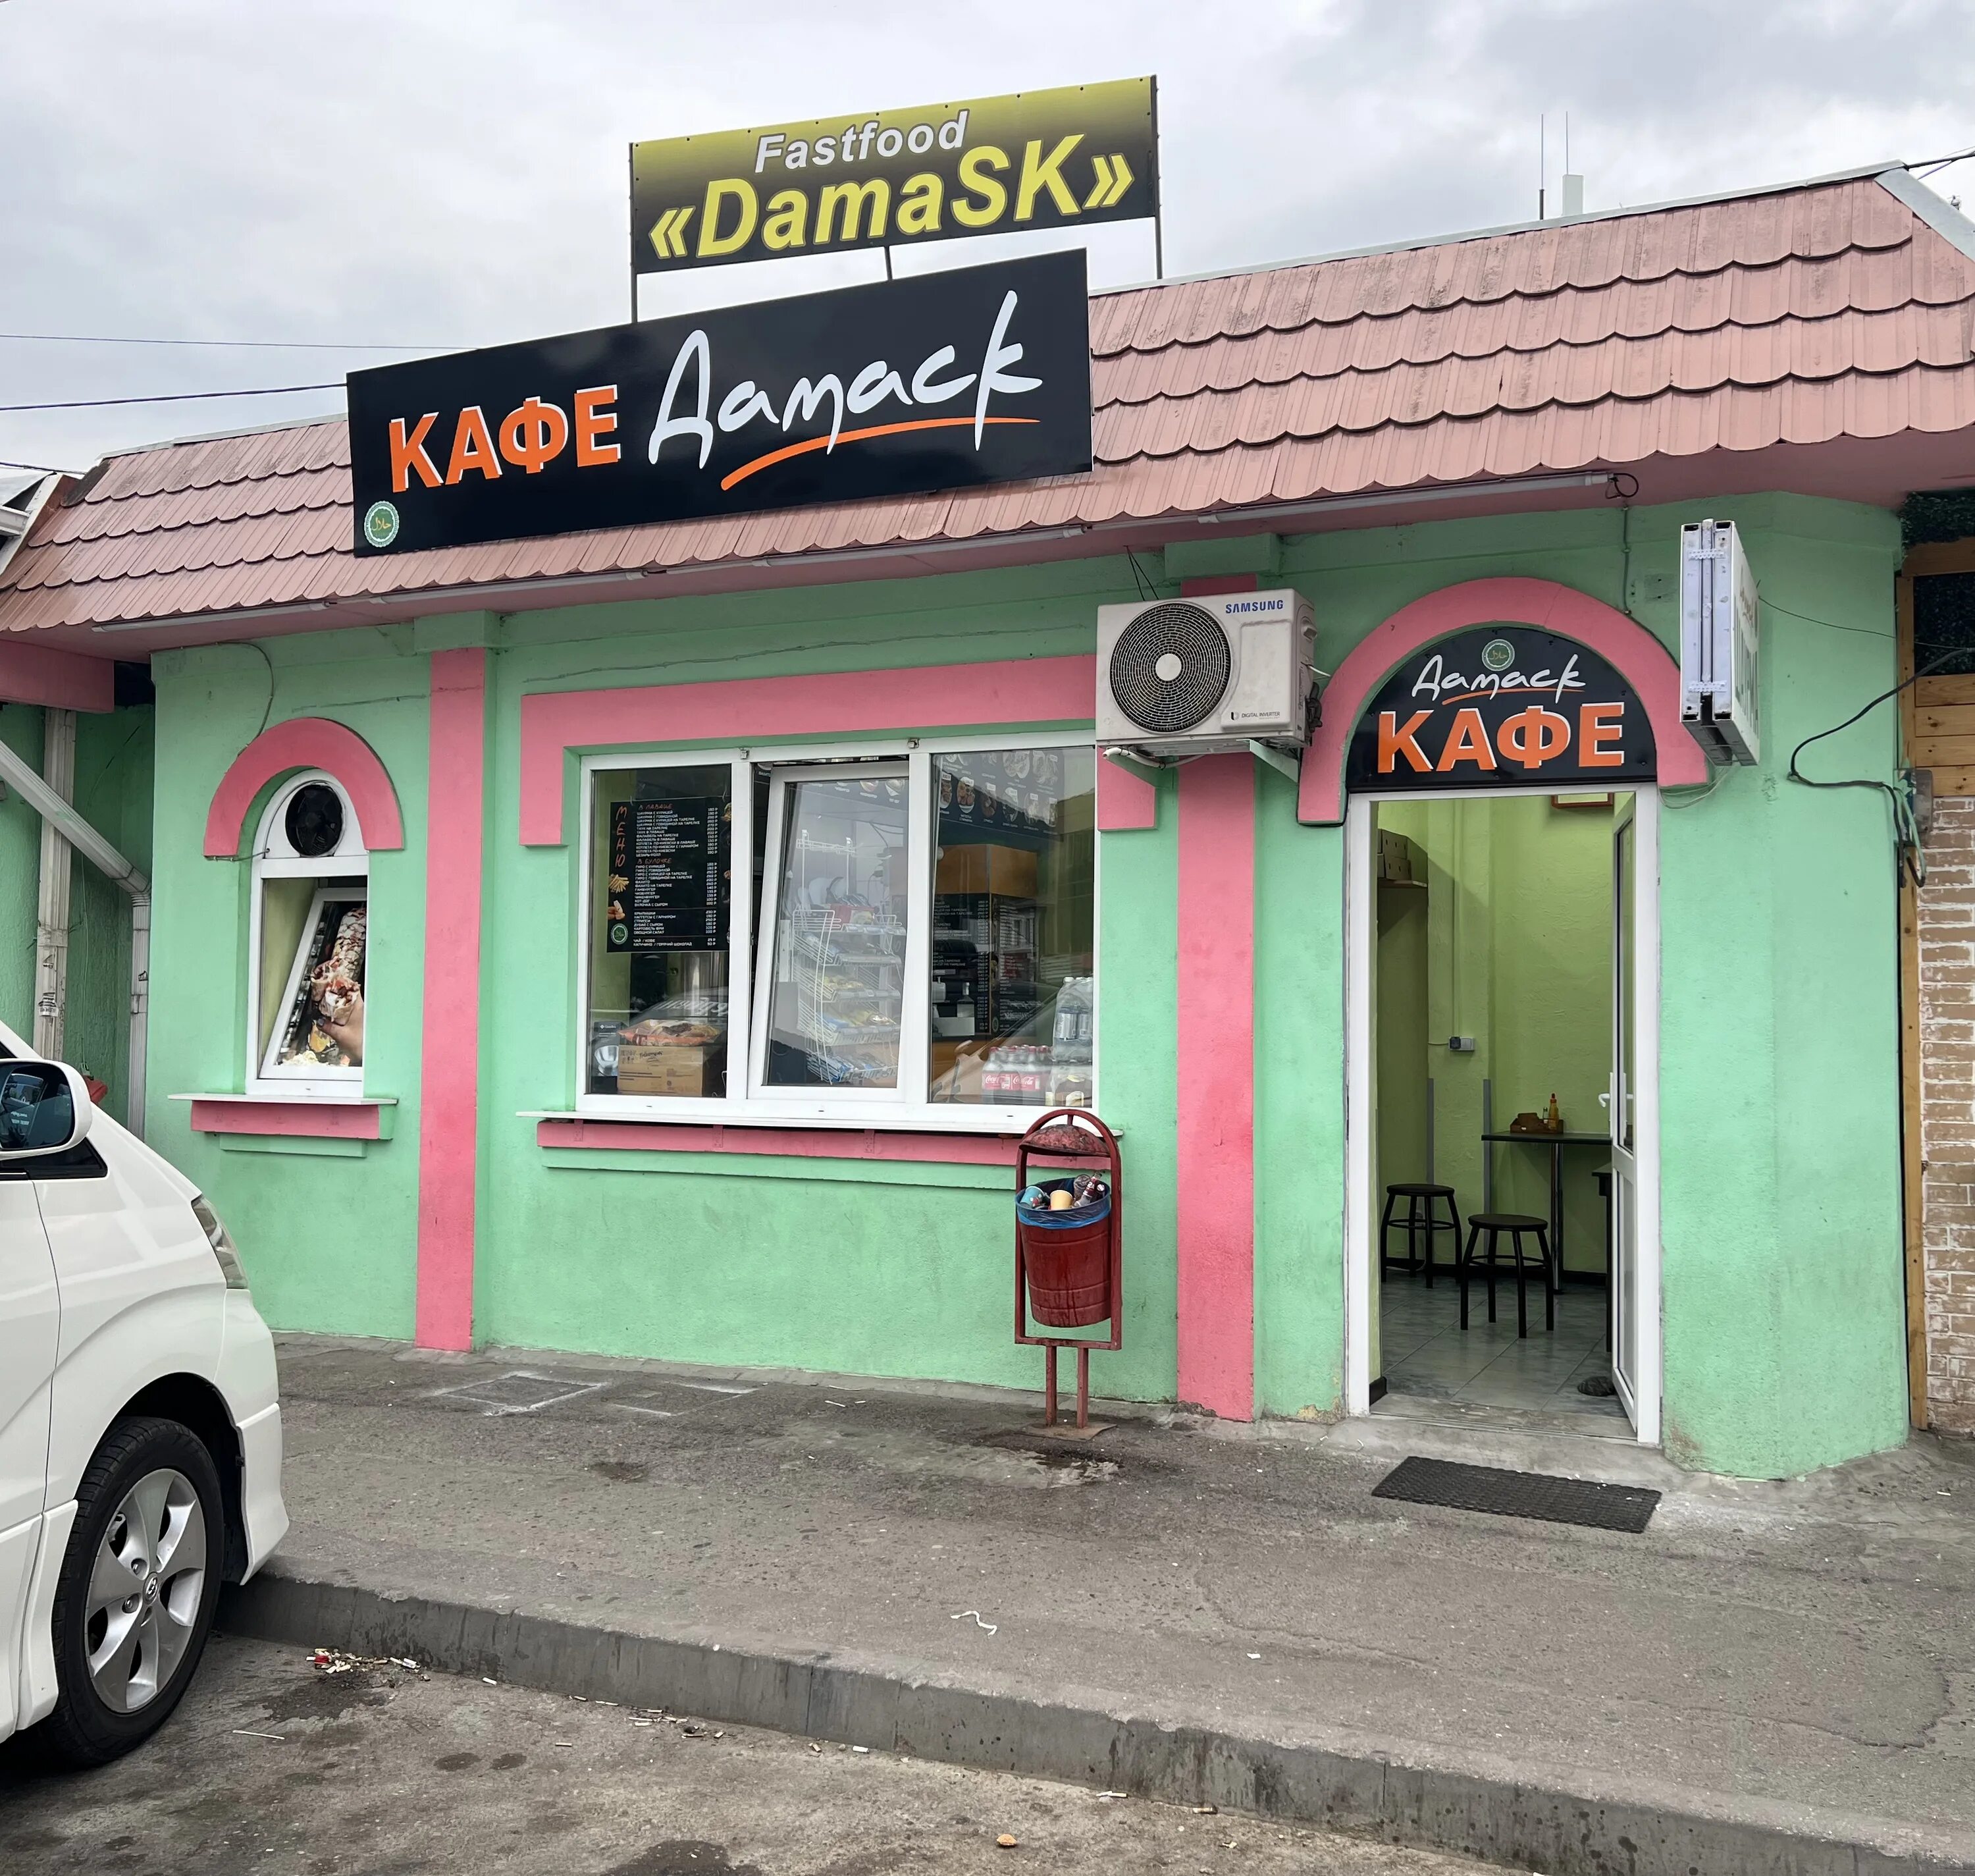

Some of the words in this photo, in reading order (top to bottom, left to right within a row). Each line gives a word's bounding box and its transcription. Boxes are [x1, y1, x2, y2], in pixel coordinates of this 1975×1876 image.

[756, 110, 969, 173] Fastfood
[649, 134, 1134, 258] «DamaSK»
[389, 385, 621, 492] КАФЕ
[648, 290, 1043, 469] Дамаск
[1226, 599, 1284, 614] SAMSUNG
[1411, 654, 1586, 704] Дамаск
[1377, 701, 1625, 774] КАФЕ
